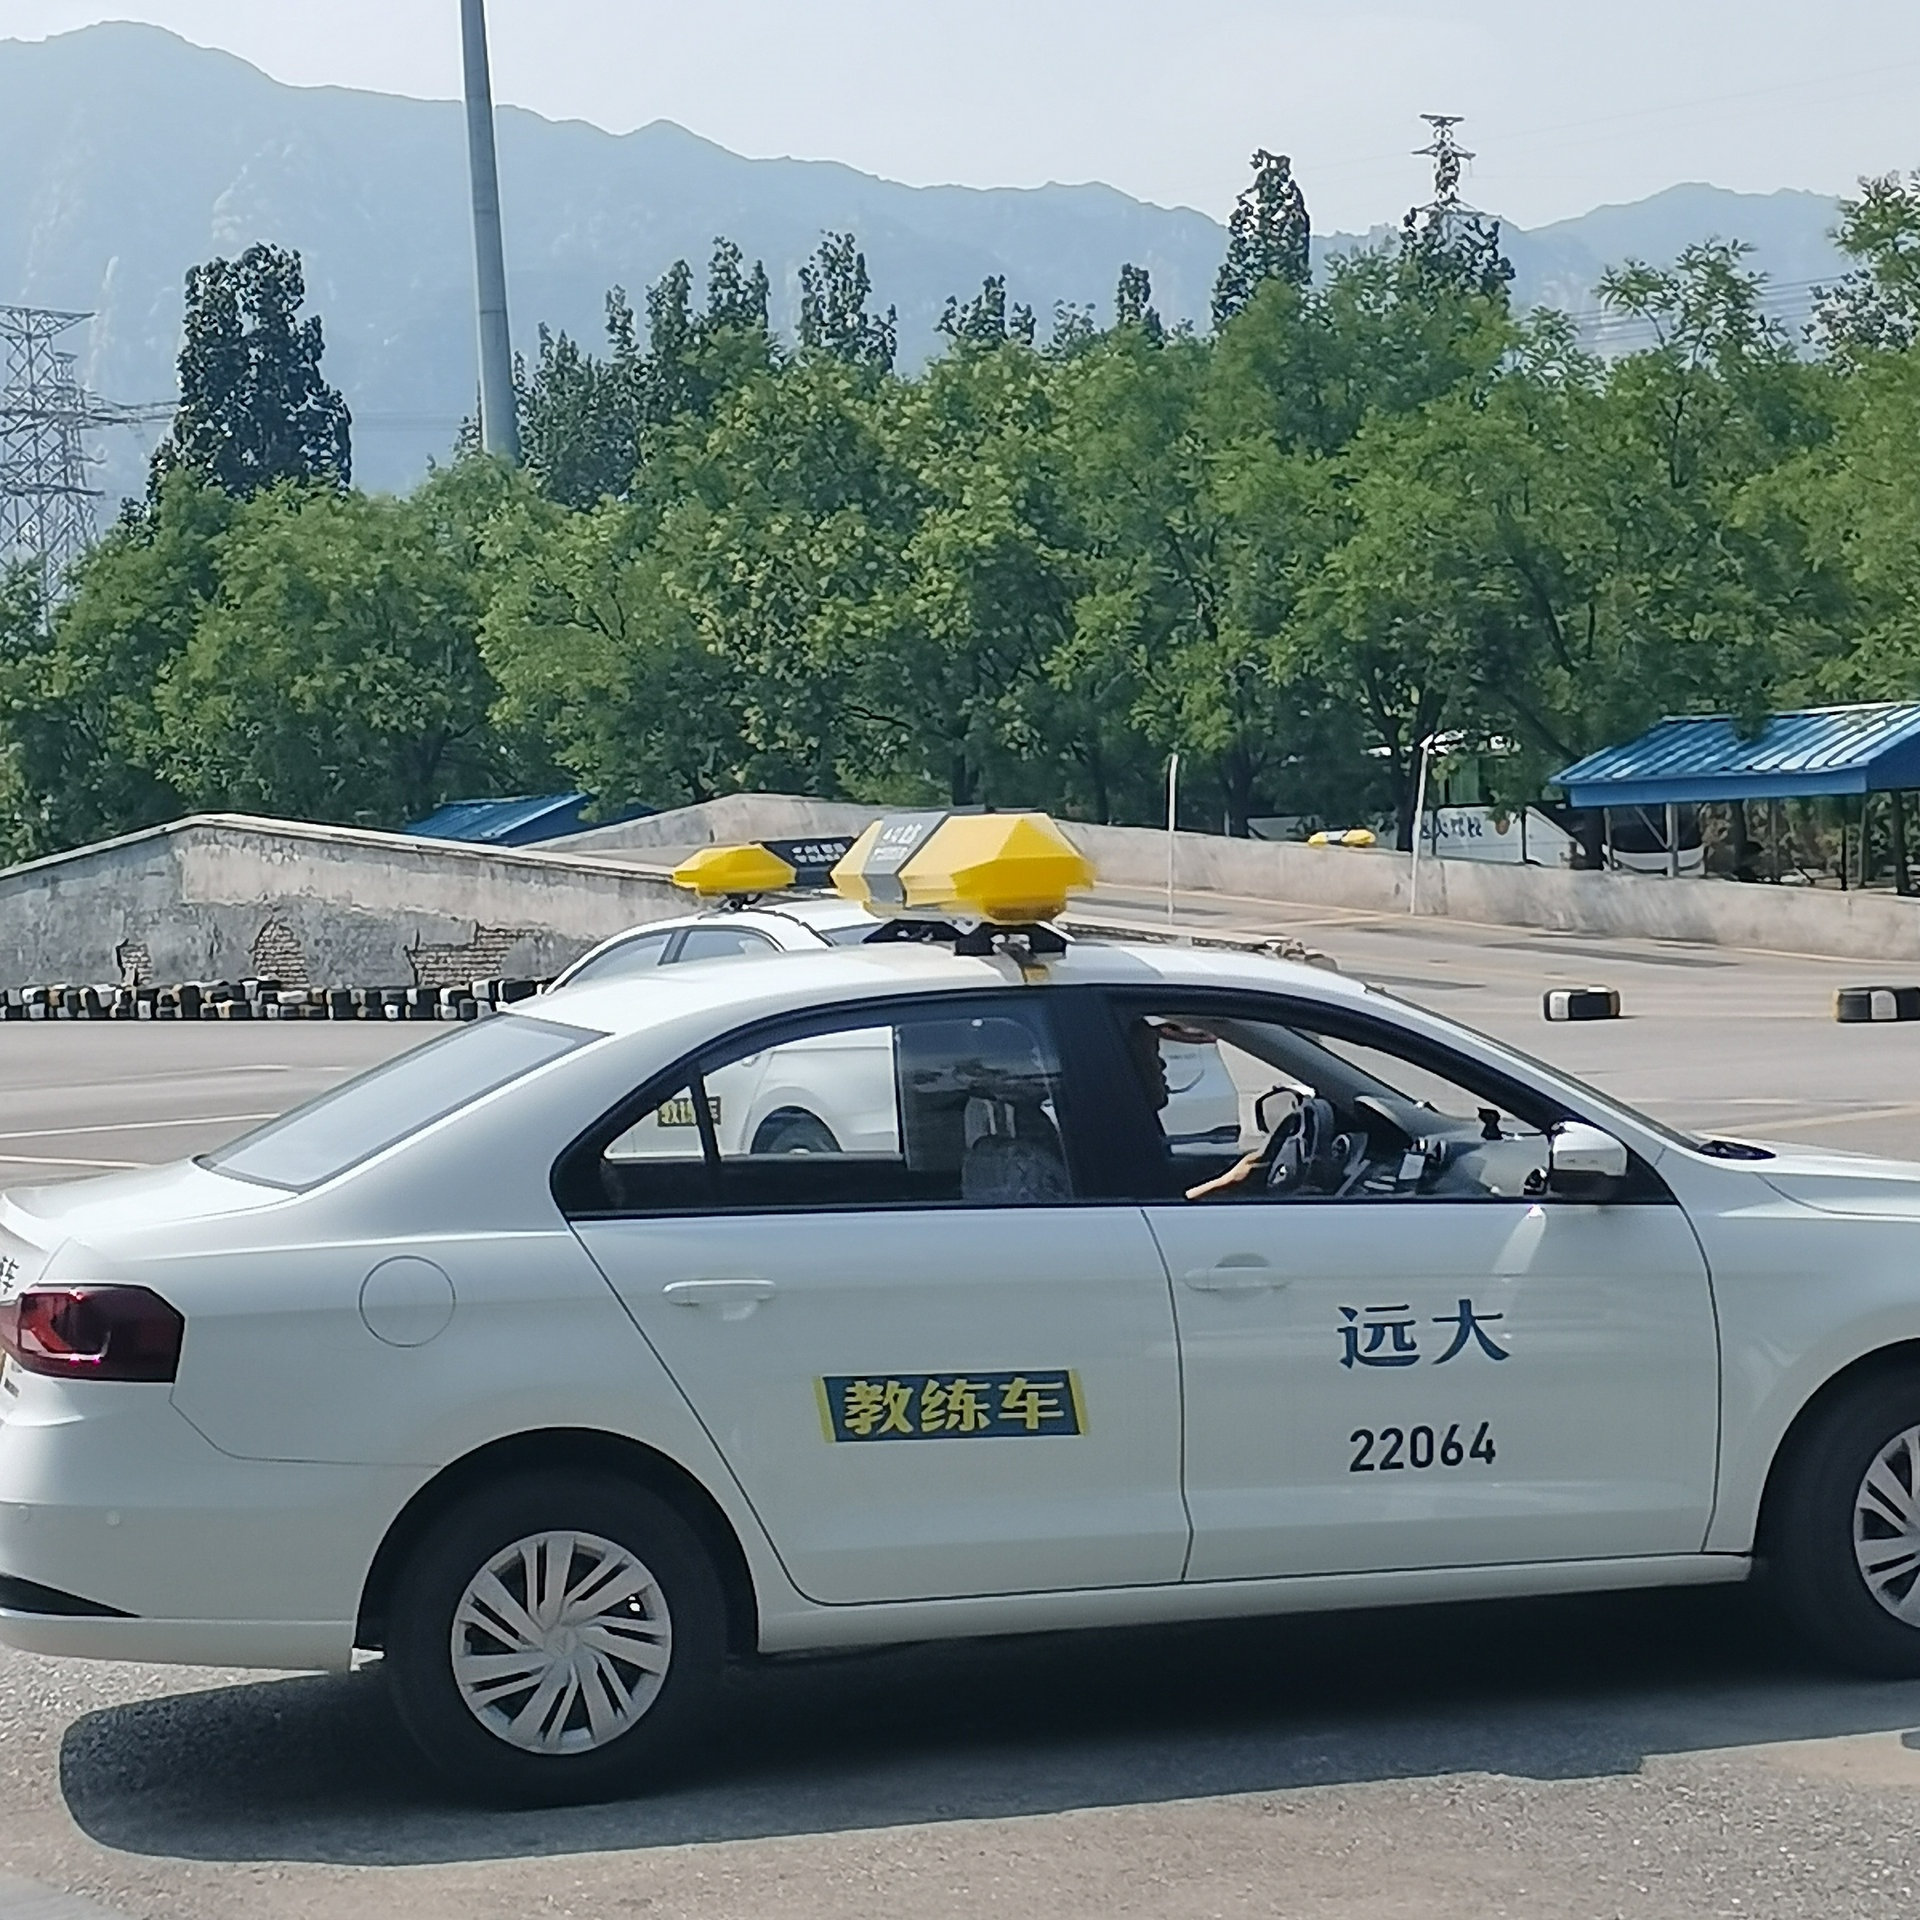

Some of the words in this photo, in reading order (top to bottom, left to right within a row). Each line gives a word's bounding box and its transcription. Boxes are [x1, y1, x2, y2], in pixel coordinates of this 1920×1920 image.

[1337, 1298, 1511, 1369] 远大
[843, 1376, 1065, 1435] 教练车
[1349, 1420, 1496, 1473] 22064
